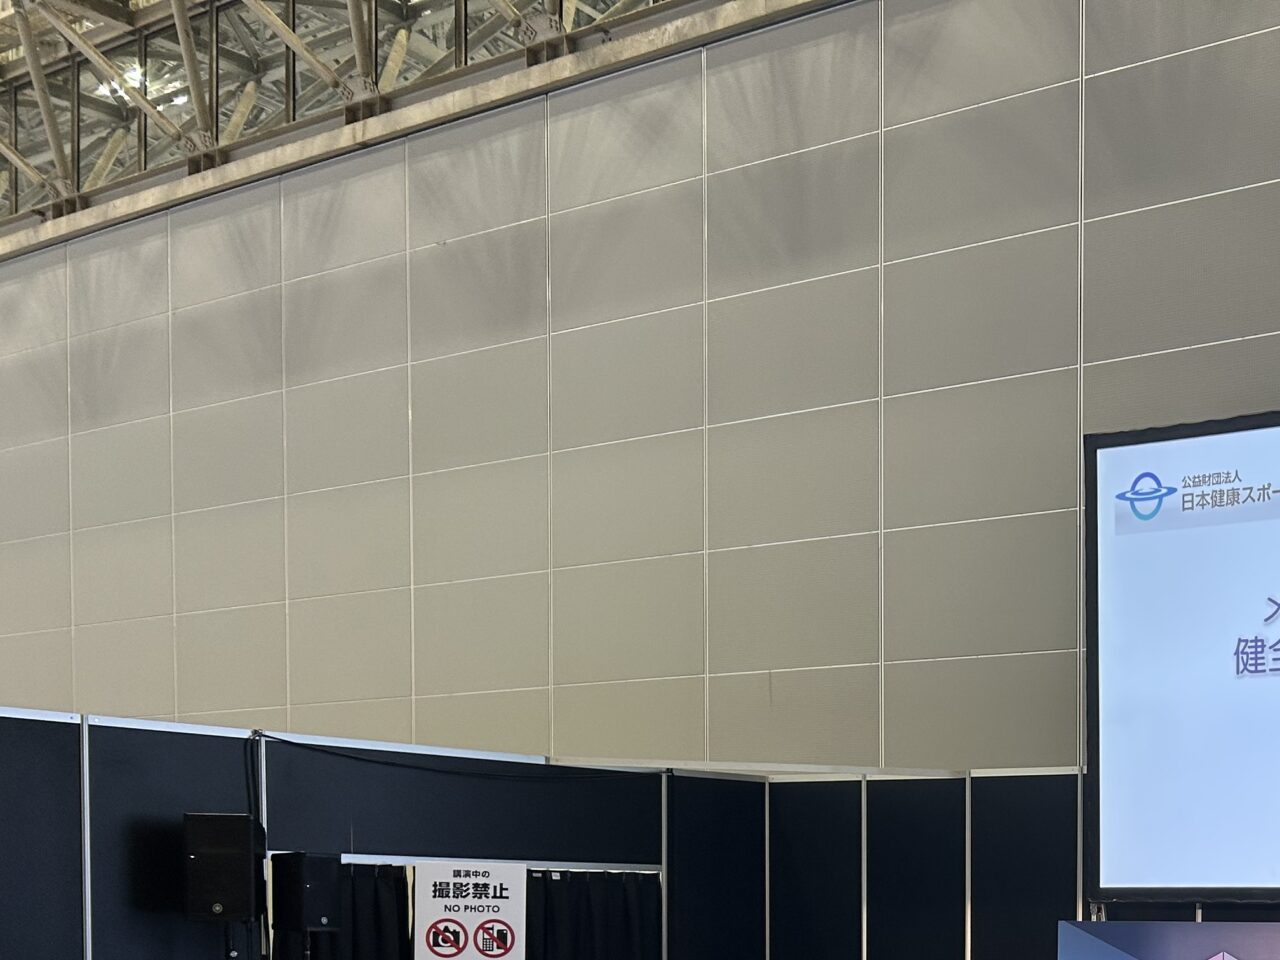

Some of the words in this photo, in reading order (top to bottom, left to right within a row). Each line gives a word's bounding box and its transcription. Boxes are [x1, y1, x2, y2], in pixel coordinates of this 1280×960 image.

[1181, 469, 1242, 489] 公益財団法人
[452, 869, 490, 879] 講演中の
[432, 881, 510, 899] 撮影禁止
[444, 904, 461, 913] NO
[464, 904, 501, 913] PHOTO
